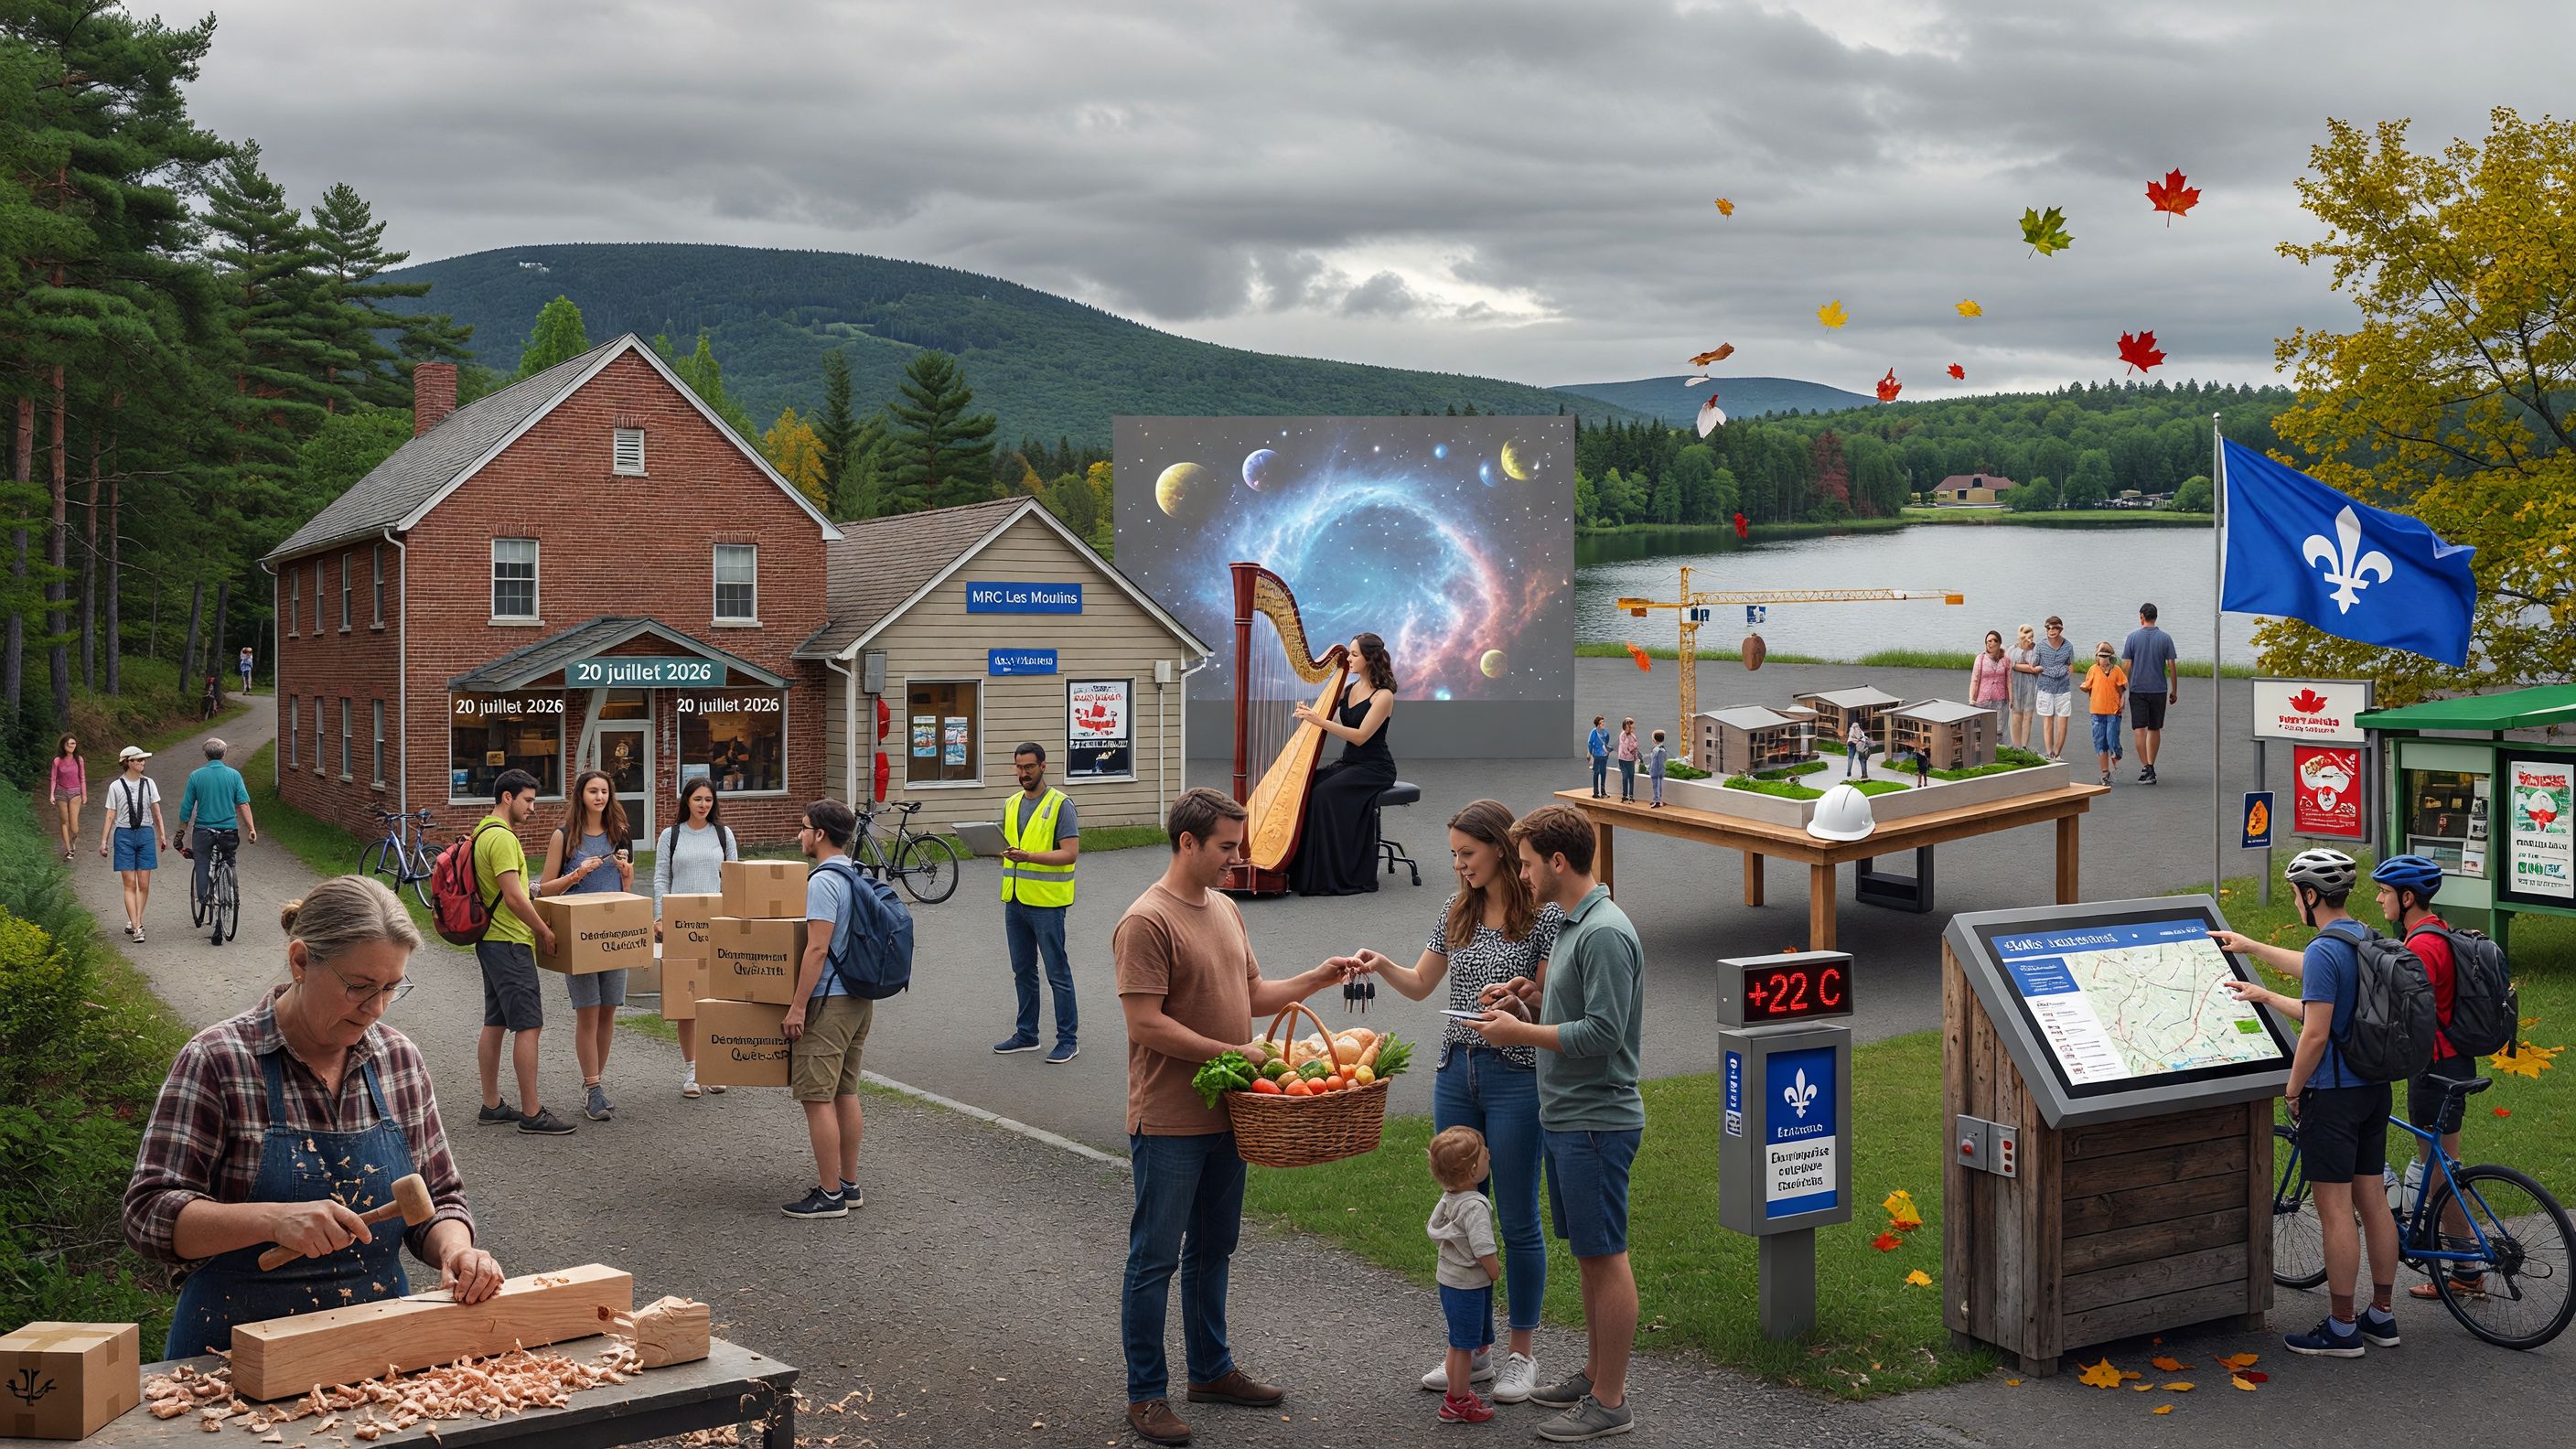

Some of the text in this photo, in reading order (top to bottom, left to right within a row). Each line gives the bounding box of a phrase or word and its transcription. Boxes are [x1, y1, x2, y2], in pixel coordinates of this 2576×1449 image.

[972, 590, 1078, 604] MRC Les Moulins
[577, 663, 711, 684] 20 juillet 2026
[456, 698, 564, 717] 20 juillet 2026
[677, 697, 779, 715] 20 juillet 2026
[1748, 968, 1841, 1013] +22 C
